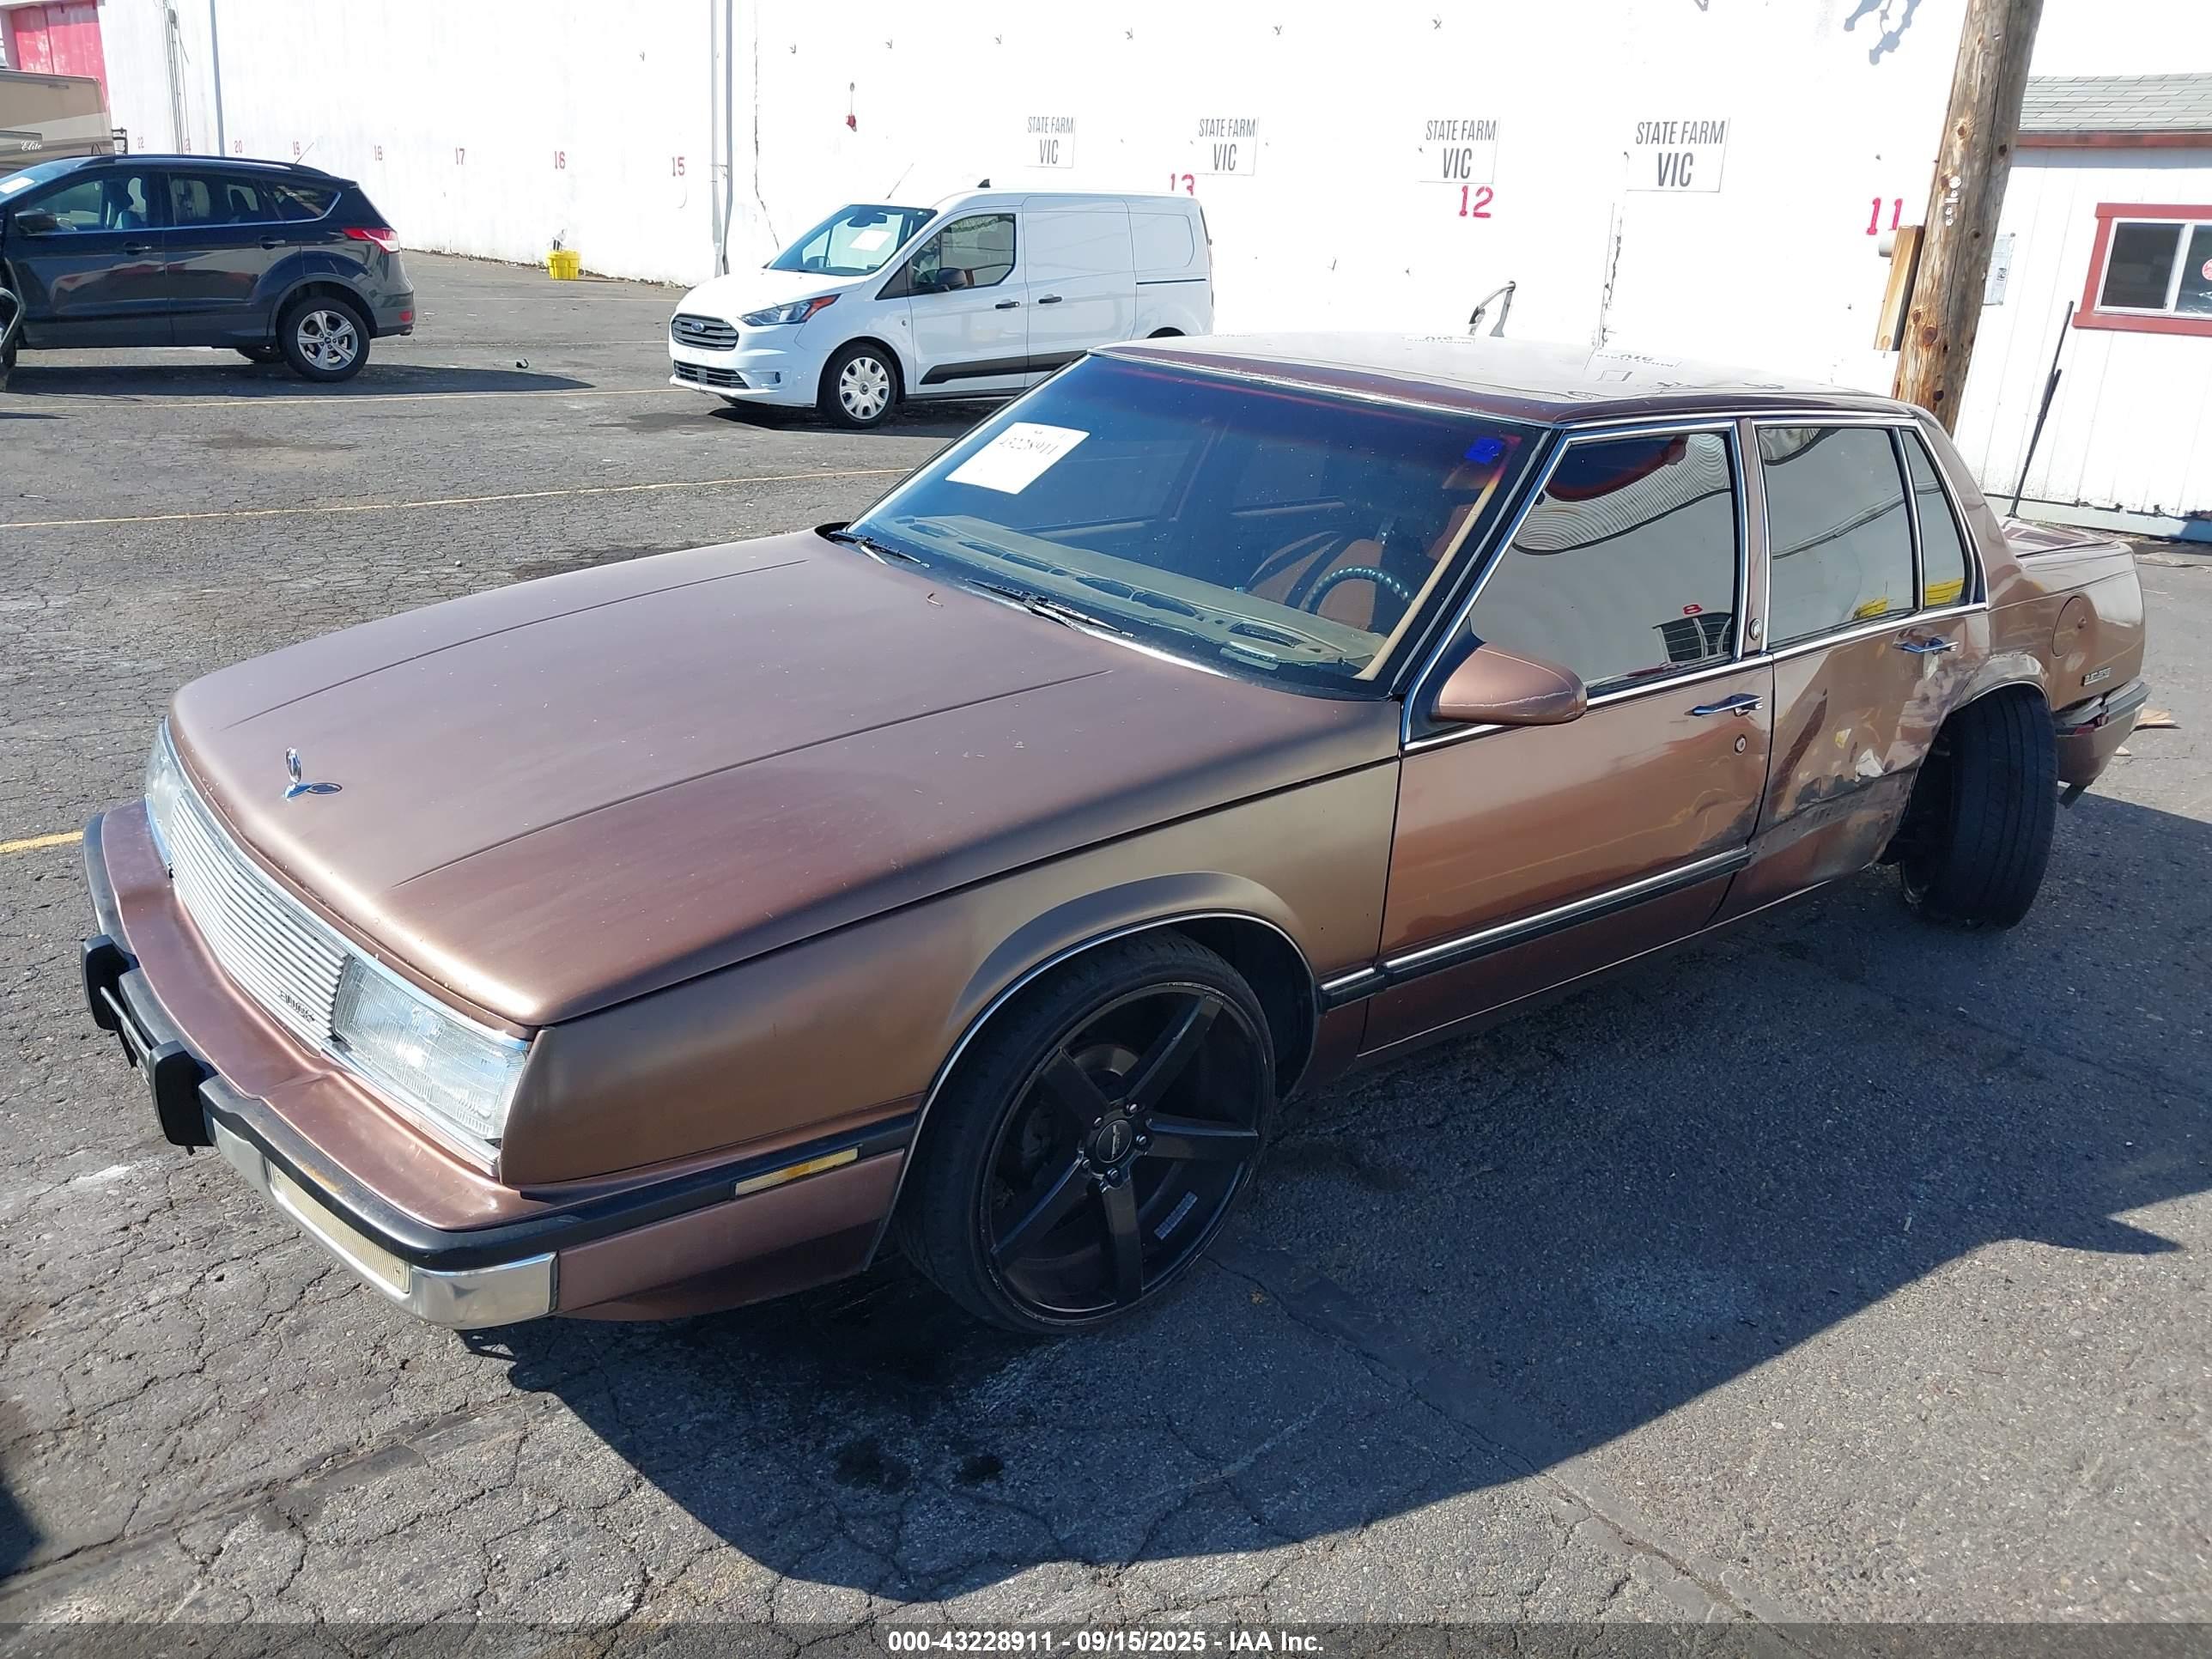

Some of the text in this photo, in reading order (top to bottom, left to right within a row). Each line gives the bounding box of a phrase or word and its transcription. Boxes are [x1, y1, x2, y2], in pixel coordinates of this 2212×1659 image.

[1027, 116, 1073, 134] STATE FARM
[1199, 118, 1255, 138] STATE FARM
[1425, 119, 1497, 141] STATE FARM
[1635, 120, 1726, 145] STATE FARM
[20, 138, 43, 152] Elite
[234, 139, 243, 154] 20
[292, 140, 301, 156] 19
[374, 144, 383, 161] 18
[1039, 139, 1059, 165] VIC
[455, 147, 465, 166] 17
[554, 150, 566, 170] 16
[672, 155, 686, 177] 15
[1213, 143, 1237, 172] VIC
[1443, 148, 1473, 179] VIC
[1657, 151, 1694, 187] VIC
[1459, 185, 1494, 219] 12
[1866, 197, 1904, 236] 11
